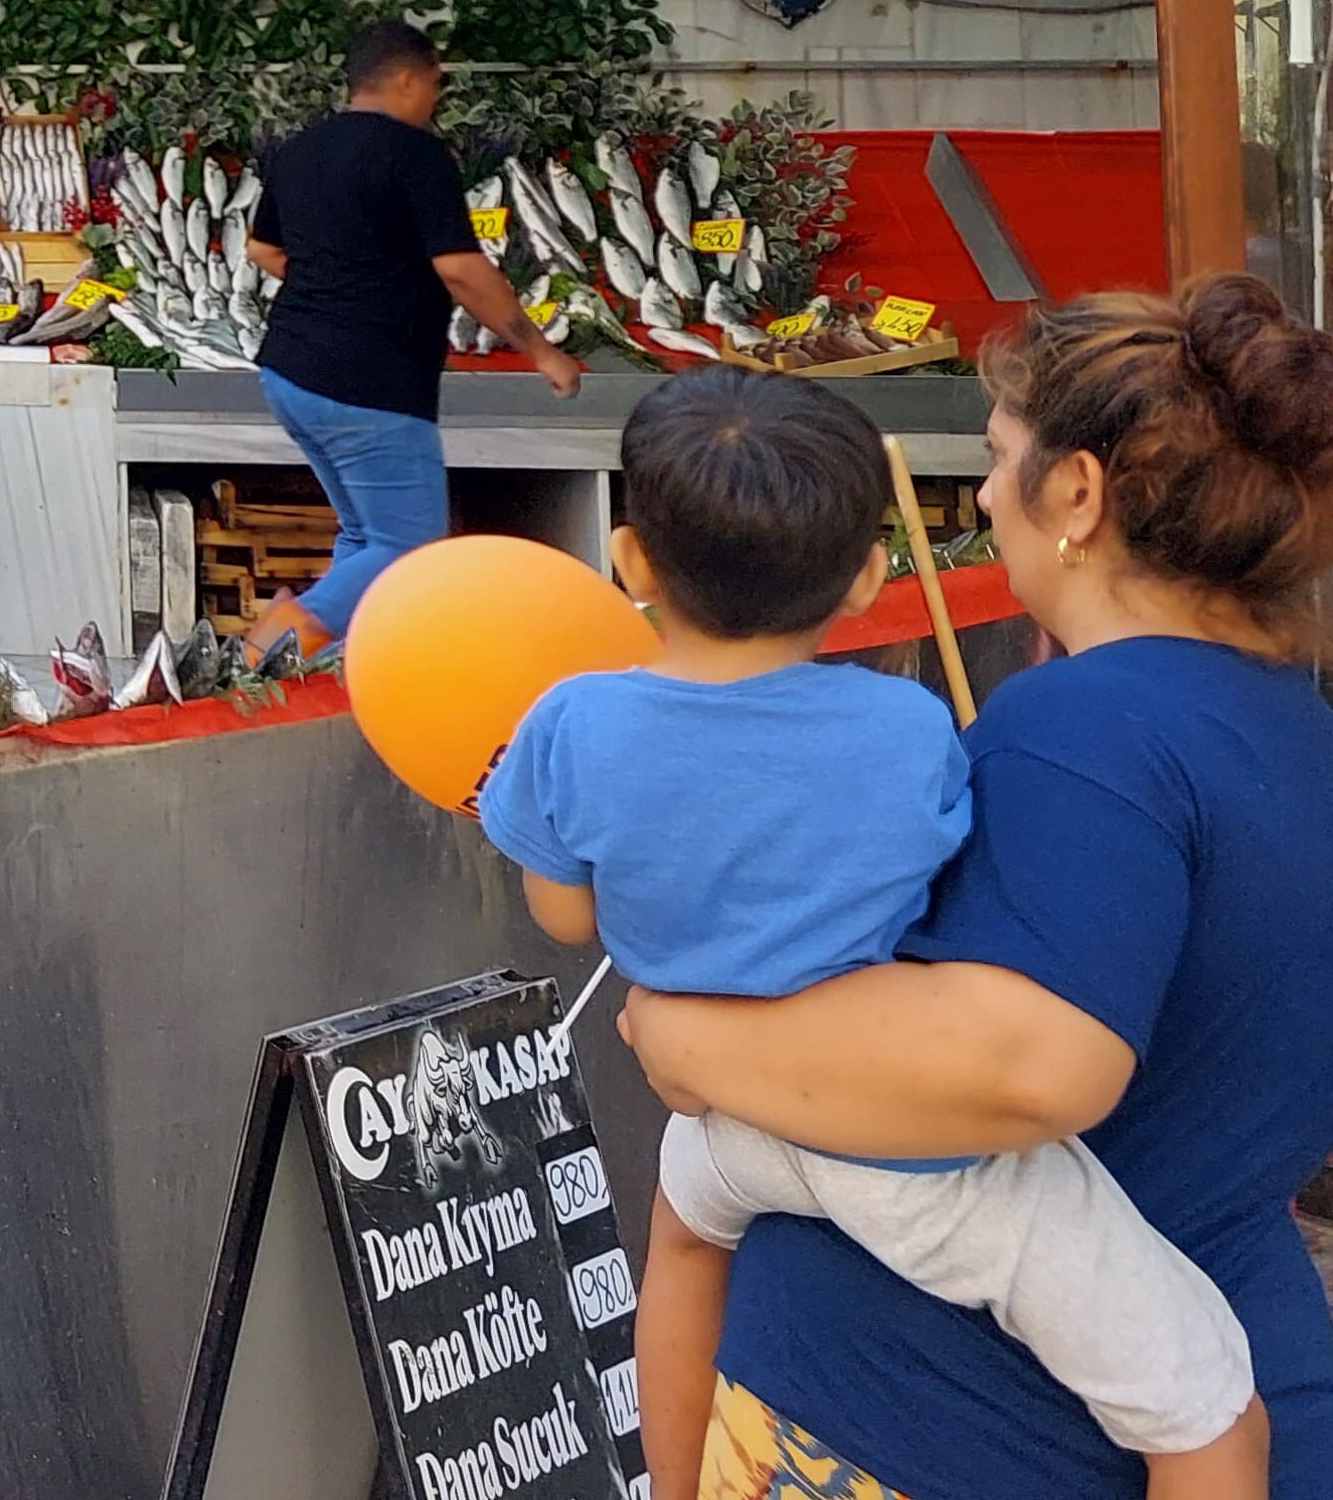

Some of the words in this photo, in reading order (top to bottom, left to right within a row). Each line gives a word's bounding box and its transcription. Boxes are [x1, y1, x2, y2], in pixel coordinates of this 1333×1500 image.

[471, 1023, 575, 1106] KASAP
[361, 1222, 449, 1302] Dana
[435, 1186, 538, 1278] Kıyma
[388, 1326, 475, 1415] Dana
[463, 1284, 548, 1384] Köfte
[415, 1440, 504, 1500] Dana
[493, 1381, 589, 1491] Sucuk
